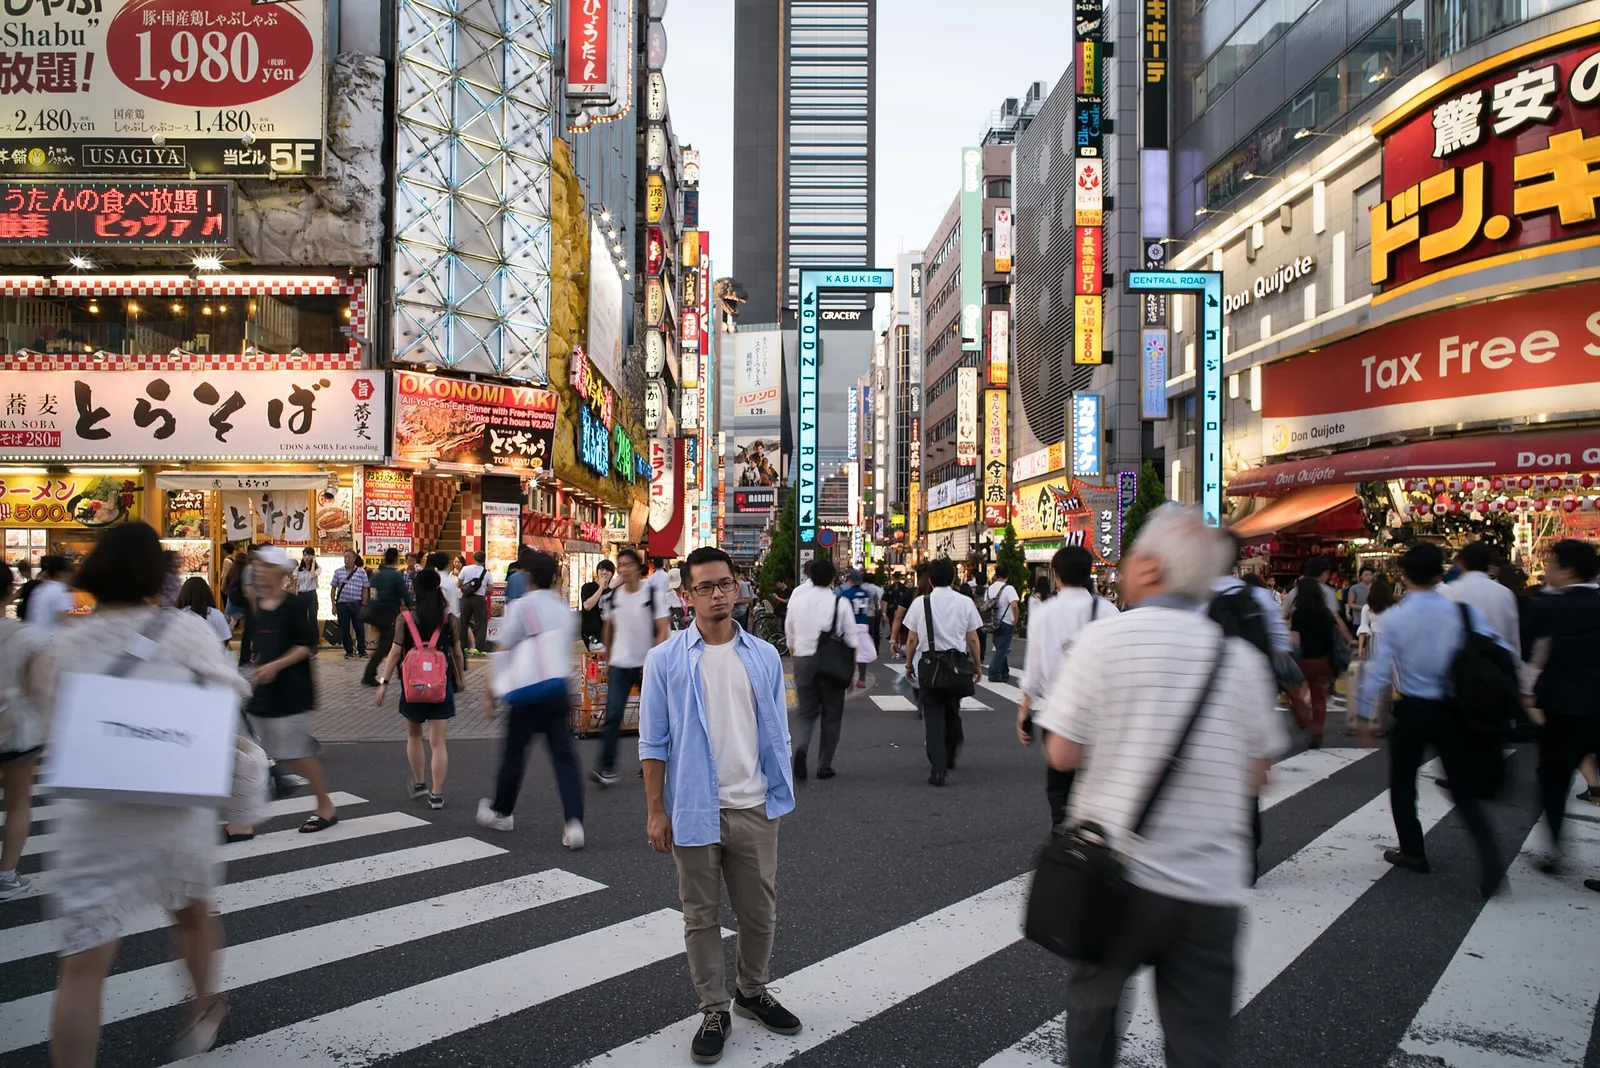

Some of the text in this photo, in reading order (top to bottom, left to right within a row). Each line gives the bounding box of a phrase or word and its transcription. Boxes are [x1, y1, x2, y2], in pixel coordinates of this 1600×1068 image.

[135, 30, 294, 90] 1,980 yen
[582, 84, 595, 92] 7F
[15, 109, 72, 134] 2,480
[72, 121, 95, 133] yen
[194, 110, 250, 134] 1,480
[251, 122, 275, 134] yen
[90, 148, 180, 164] USAGIYA
[270, 143, 315, 171] 5F
[1133, 276, 1206, 285] CENTRAL ROAD
[1223, 255, 1313, 316] Don Quijote
[821, 311, 861, 320] GRACERY
[1361, 352, 1423, 394] Tax
[1438, 330, 1560, 378] Free
[5, 393, 58, 416] 蕎麦
[401, 375, 505, 405] OKONOMI
[511, 388, 557, 410] YAKI
[74, 378, 331, 444] とらそば
[492, 407, 508, 416] with
[509, 408, 555, 420] Free-Flowing
[802, 309, 815, 504] GODZILLA ROAD
[1206, 328, 1220, 492] ゴジラロード
[22, 420, 56, 429] SOBA
[353, 402, 372, 440] 蕎麦
[465, 413, 554, 430] Drinks for 2 hours ¥2,500
[1290, 422, 1346, 443] Don Quijote
[1078, 397, 1097, 471] カラオケ
[652, 443, 664, 496] トラノコ
[1517, 451, 1572, 467] Don
[1275, 467, 1336, 486] Don Quijote
[1100, 509, 1113, 557] カラオケ
